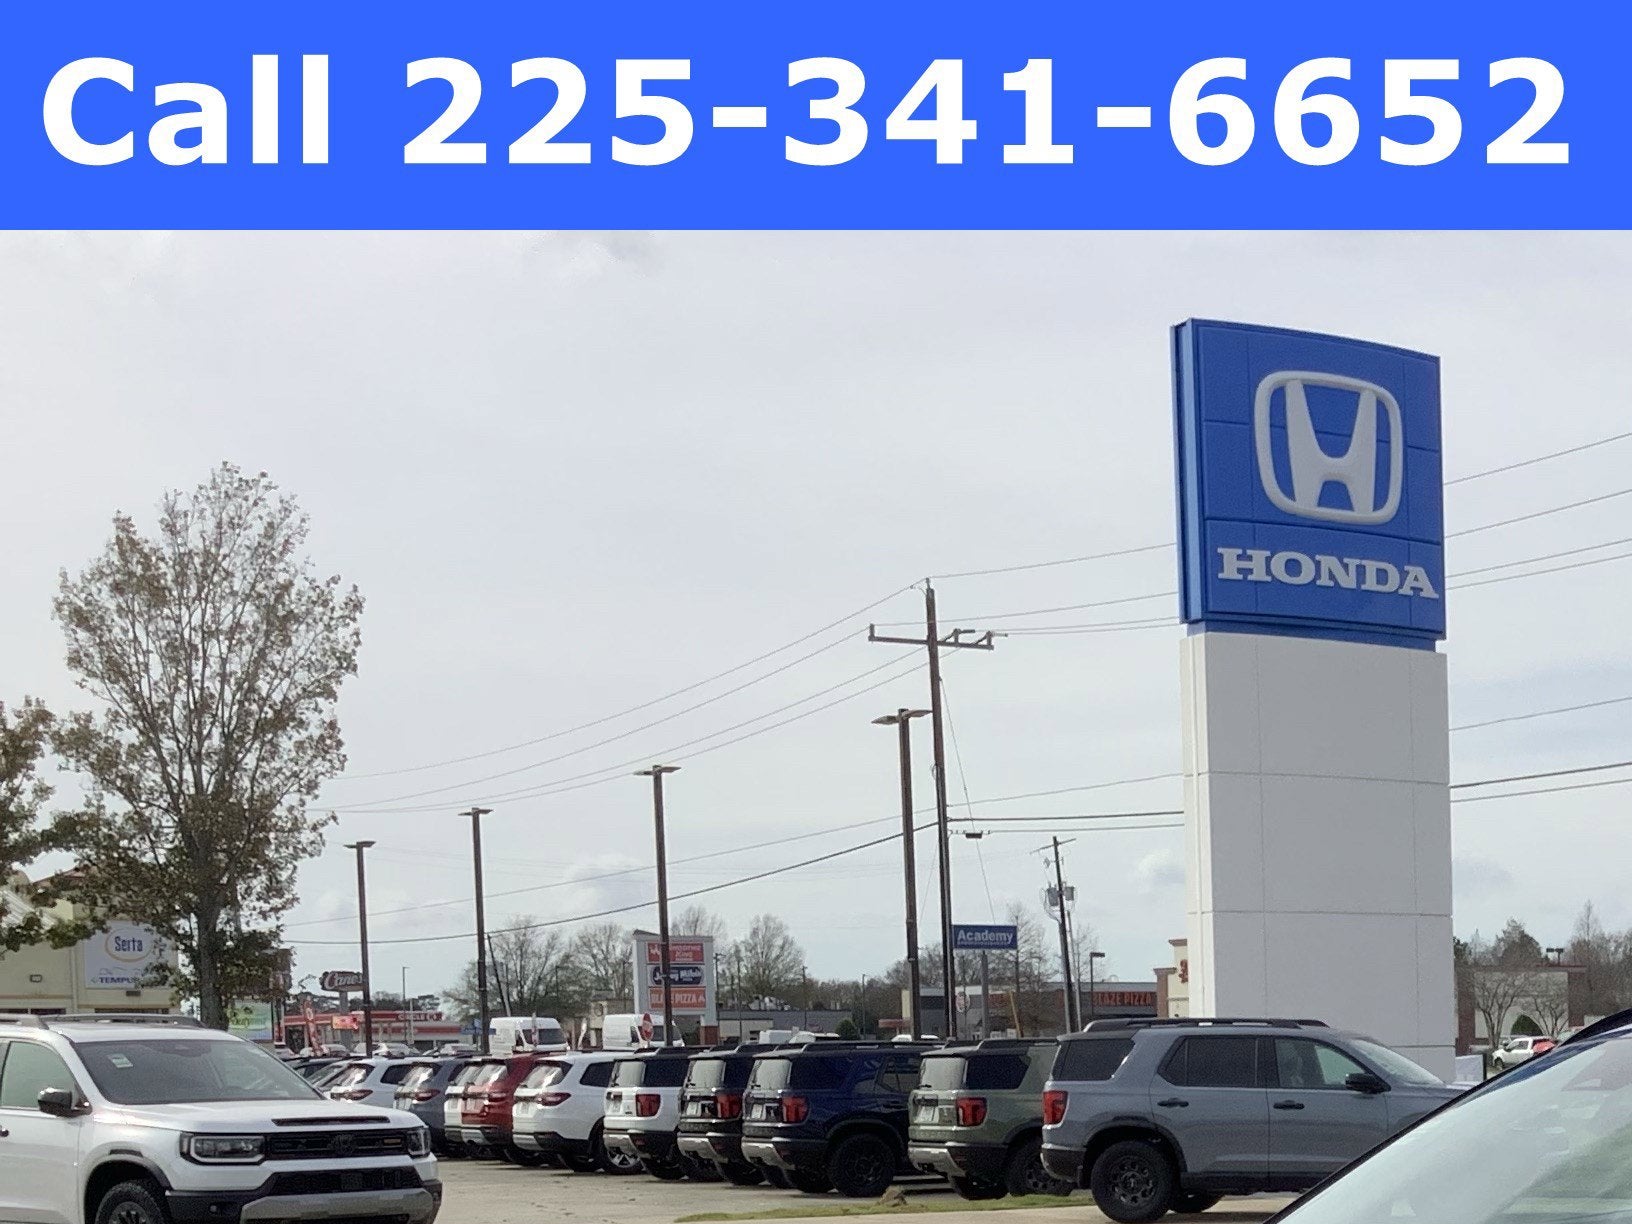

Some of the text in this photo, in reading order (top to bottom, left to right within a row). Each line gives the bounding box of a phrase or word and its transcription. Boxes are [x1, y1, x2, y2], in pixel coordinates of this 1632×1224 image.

[1216, 547, 1440, 600] HONDA
[114, 935, 144, 953] Serta
[957, 929, 1014, 945] Academy
